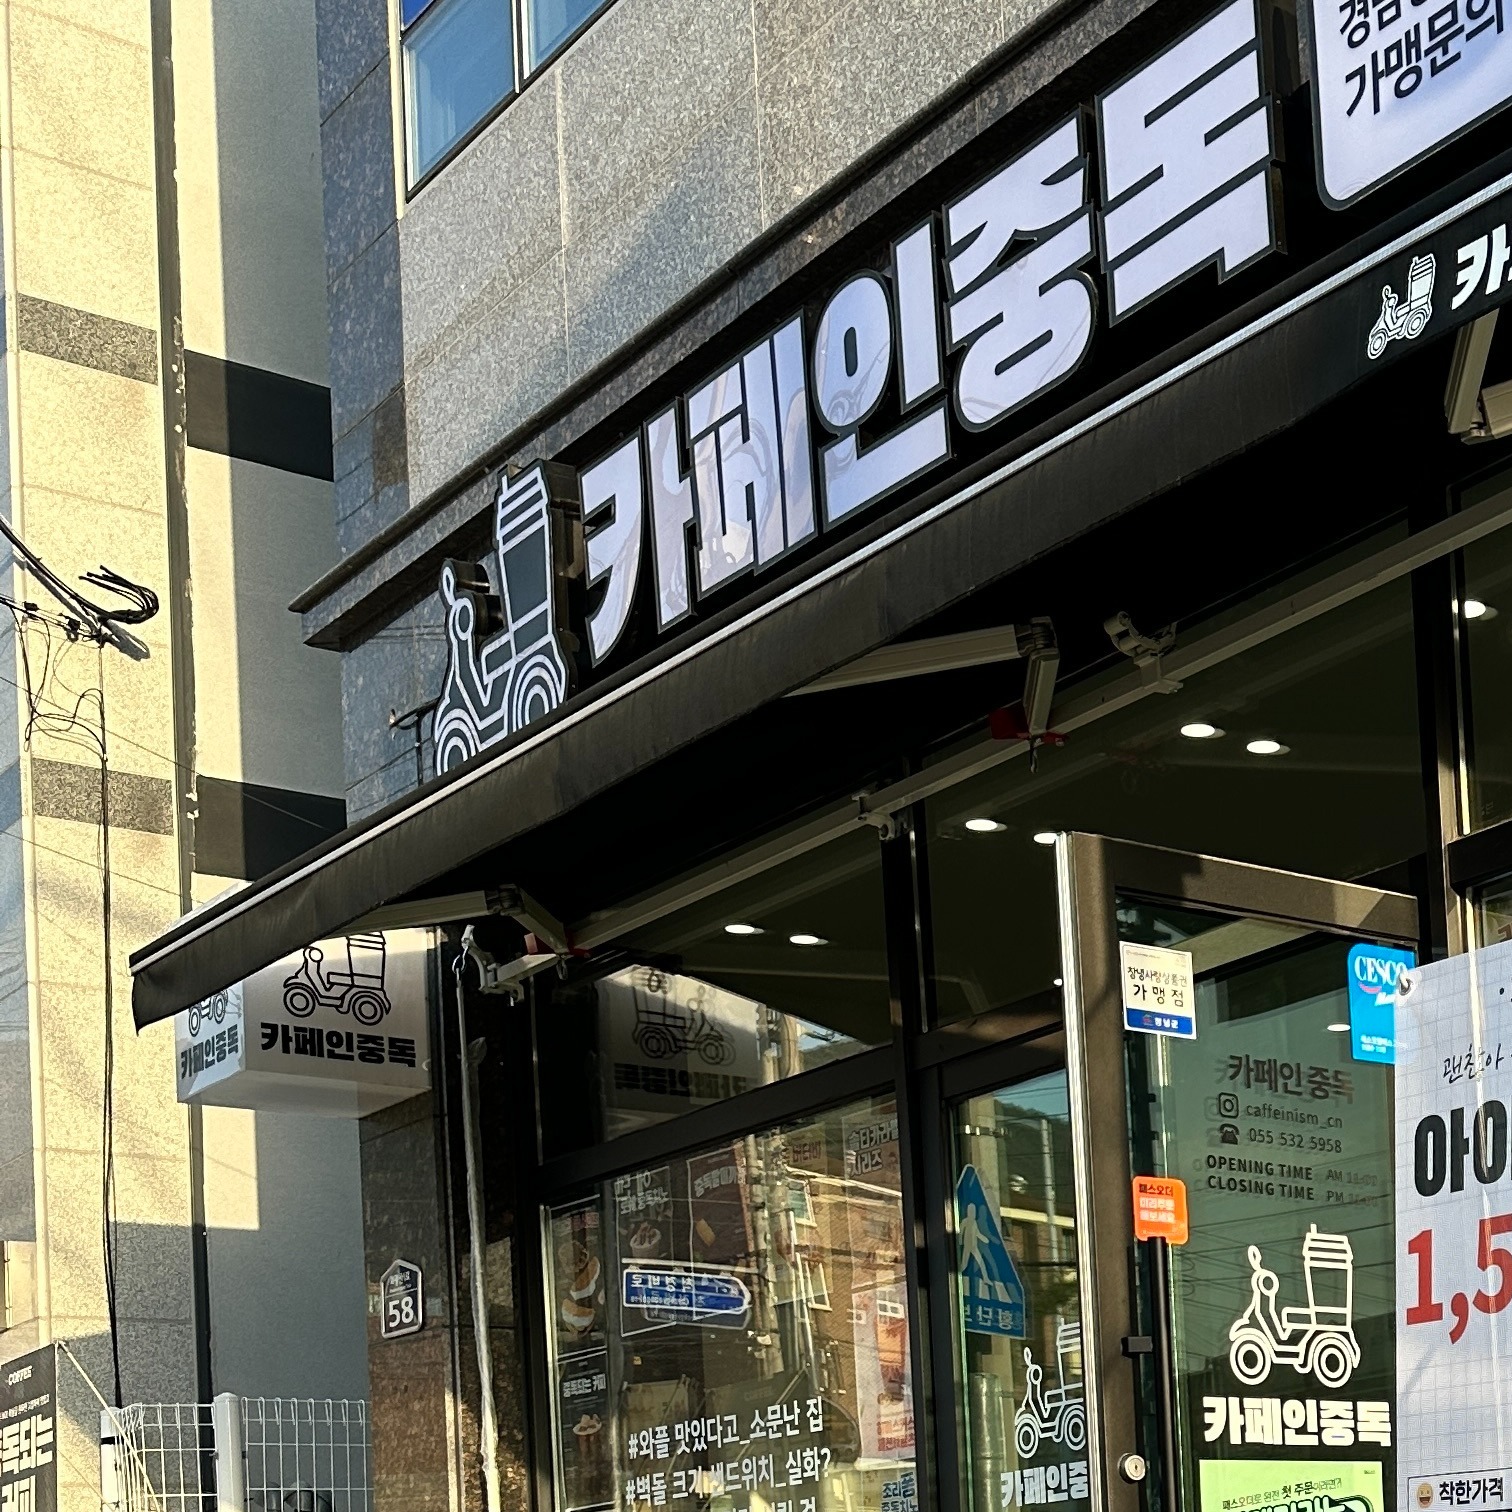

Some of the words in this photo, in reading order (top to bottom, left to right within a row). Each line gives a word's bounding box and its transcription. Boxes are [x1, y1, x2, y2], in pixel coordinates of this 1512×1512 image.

[1345, 0, 1504, 117] 가맹문의
[578, 0, 1273, 668] 카페인중독
[180, 1023, 239, 1080] 카페인중독
[260, 1022, 416, 1068] 카페인중독
[1229, 1054, 1354, 1104] 카페인중독
[1246, 1103, 1343, 1129] caffeinism_cn
[1249, 1128, 1273, 1144] 055
[1280, 1131, 1304, 1148] 532
[1310, 1136, 1342, 1153] 5958
[1207, 1155, 1275, 1176] OPENING
[1278, 1164, 1312, 1180] TIME
[1327, 1169, 1343, 1182] AM
[1208, 1176, 1275, 1196] CLOSING
[1278, 1184, 1314, 1200] TIME
[1327, 1190, 1344, 1202] PM
[389, 1296, 414, 1328] 58
[629, 1425, 670, 1460] #와플
[675, 1404, 801, 1453] 맛있다고_소문난
[806, 1396, 823, 1432] 집
[1202, 1396, 1392, 1446] 카페인중독
[0, 1414, 53, 1477] 독되는
[625, 1471, 667, 1505] #벽돌
[1001, 1460, 1089, 1508] 카페인중
[1439, 1476, 1503, 1505] 착한가격
